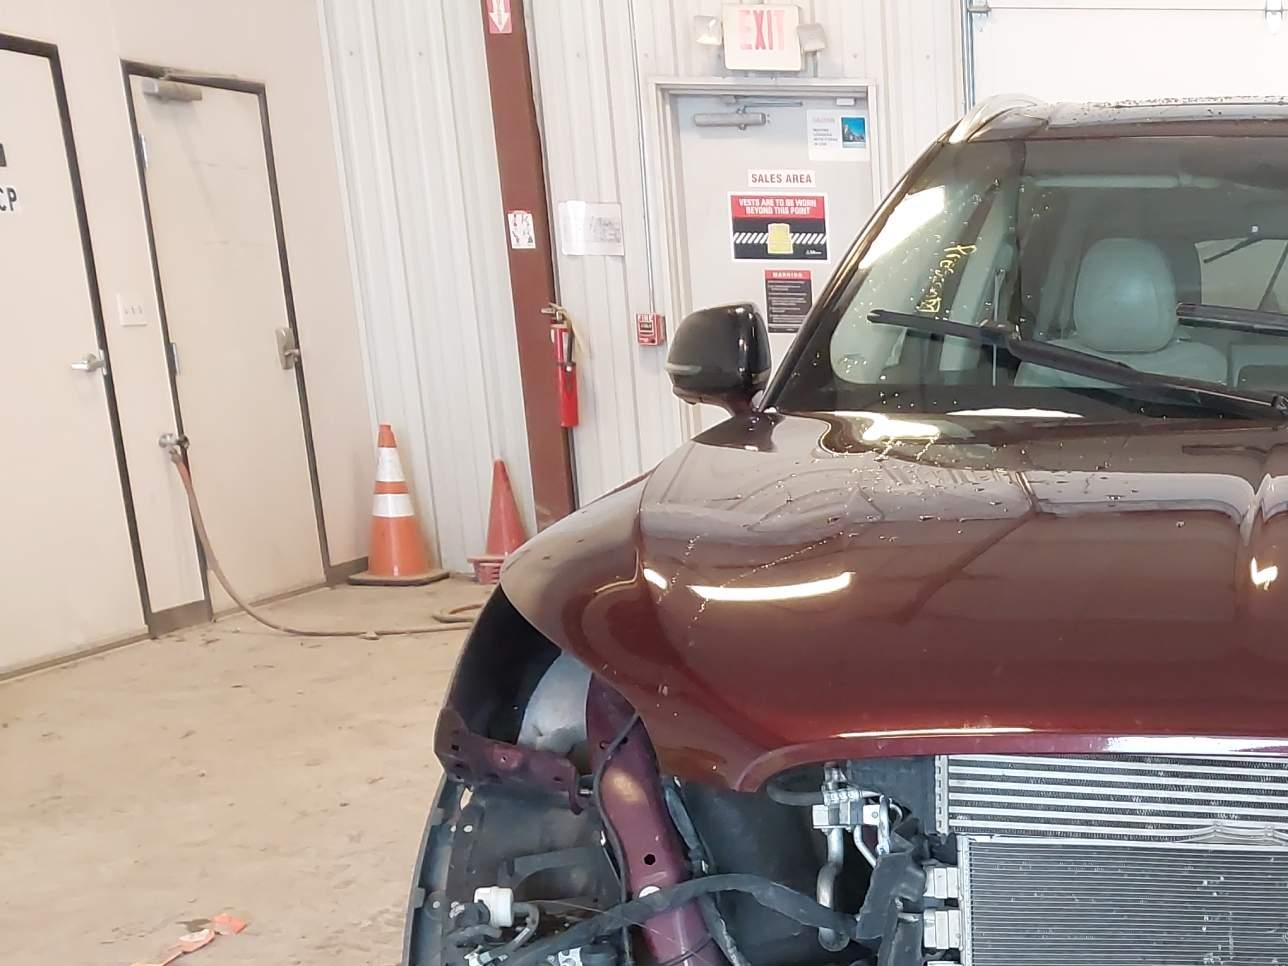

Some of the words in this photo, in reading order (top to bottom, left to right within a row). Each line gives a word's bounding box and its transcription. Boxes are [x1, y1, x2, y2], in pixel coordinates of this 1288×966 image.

[738, 9, 785, 50] EXIT
[751, 173, 783, 184] SALES
[786, 173, 812, 184] AREA
[775, 199, 785, 207] TO
[790, 206, 811, 215] POINT
